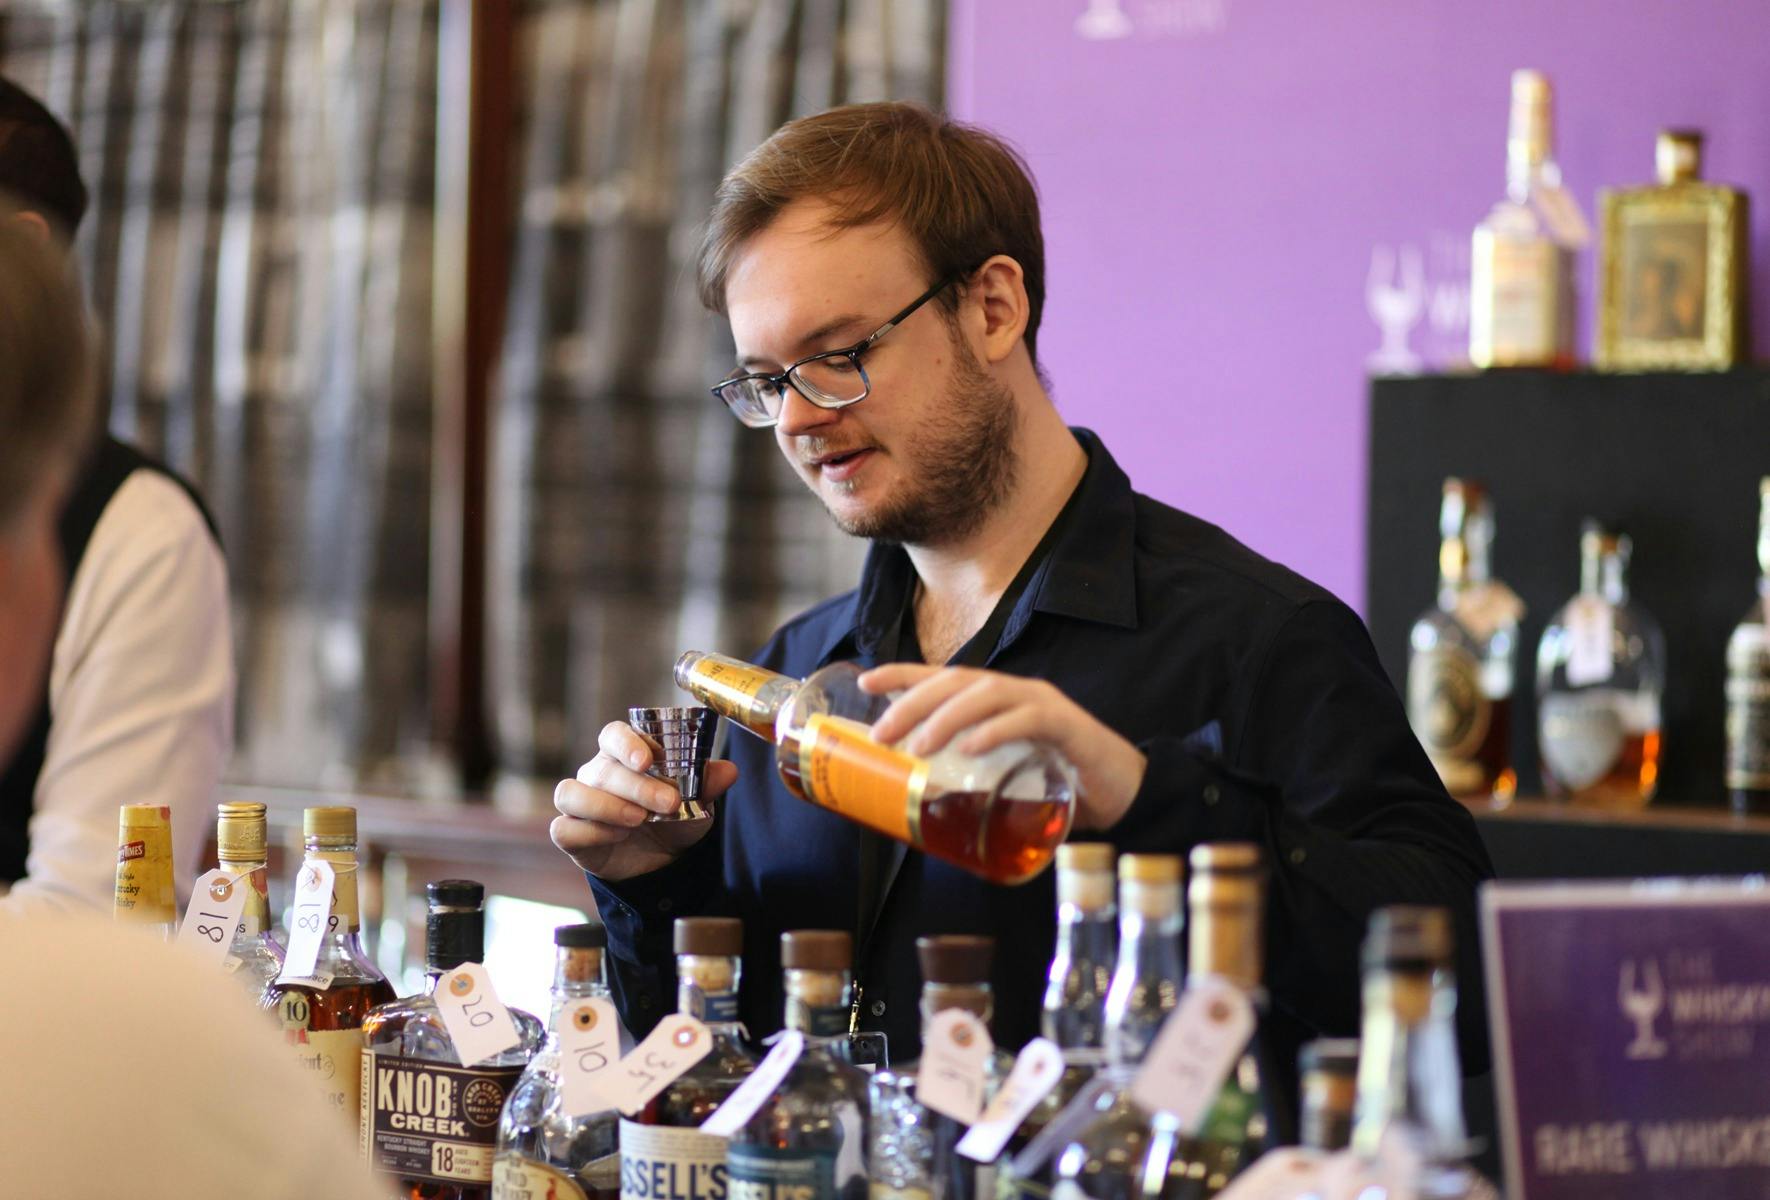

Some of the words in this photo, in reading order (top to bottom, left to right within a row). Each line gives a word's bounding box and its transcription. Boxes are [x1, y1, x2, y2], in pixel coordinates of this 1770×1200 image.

[197, 911, 229, 943] 18
[298, 903, 322, 934] 18
[286, 1001, 307, 1022] 10
[461, 995, 494, 1029] 20
[573, 1040, 608, 1073] 10
[377, 1068, 452, 1119] KNOB
[389, 1113, 467, 1137] CREEK
[436, 1146, 454, 1172] 18
